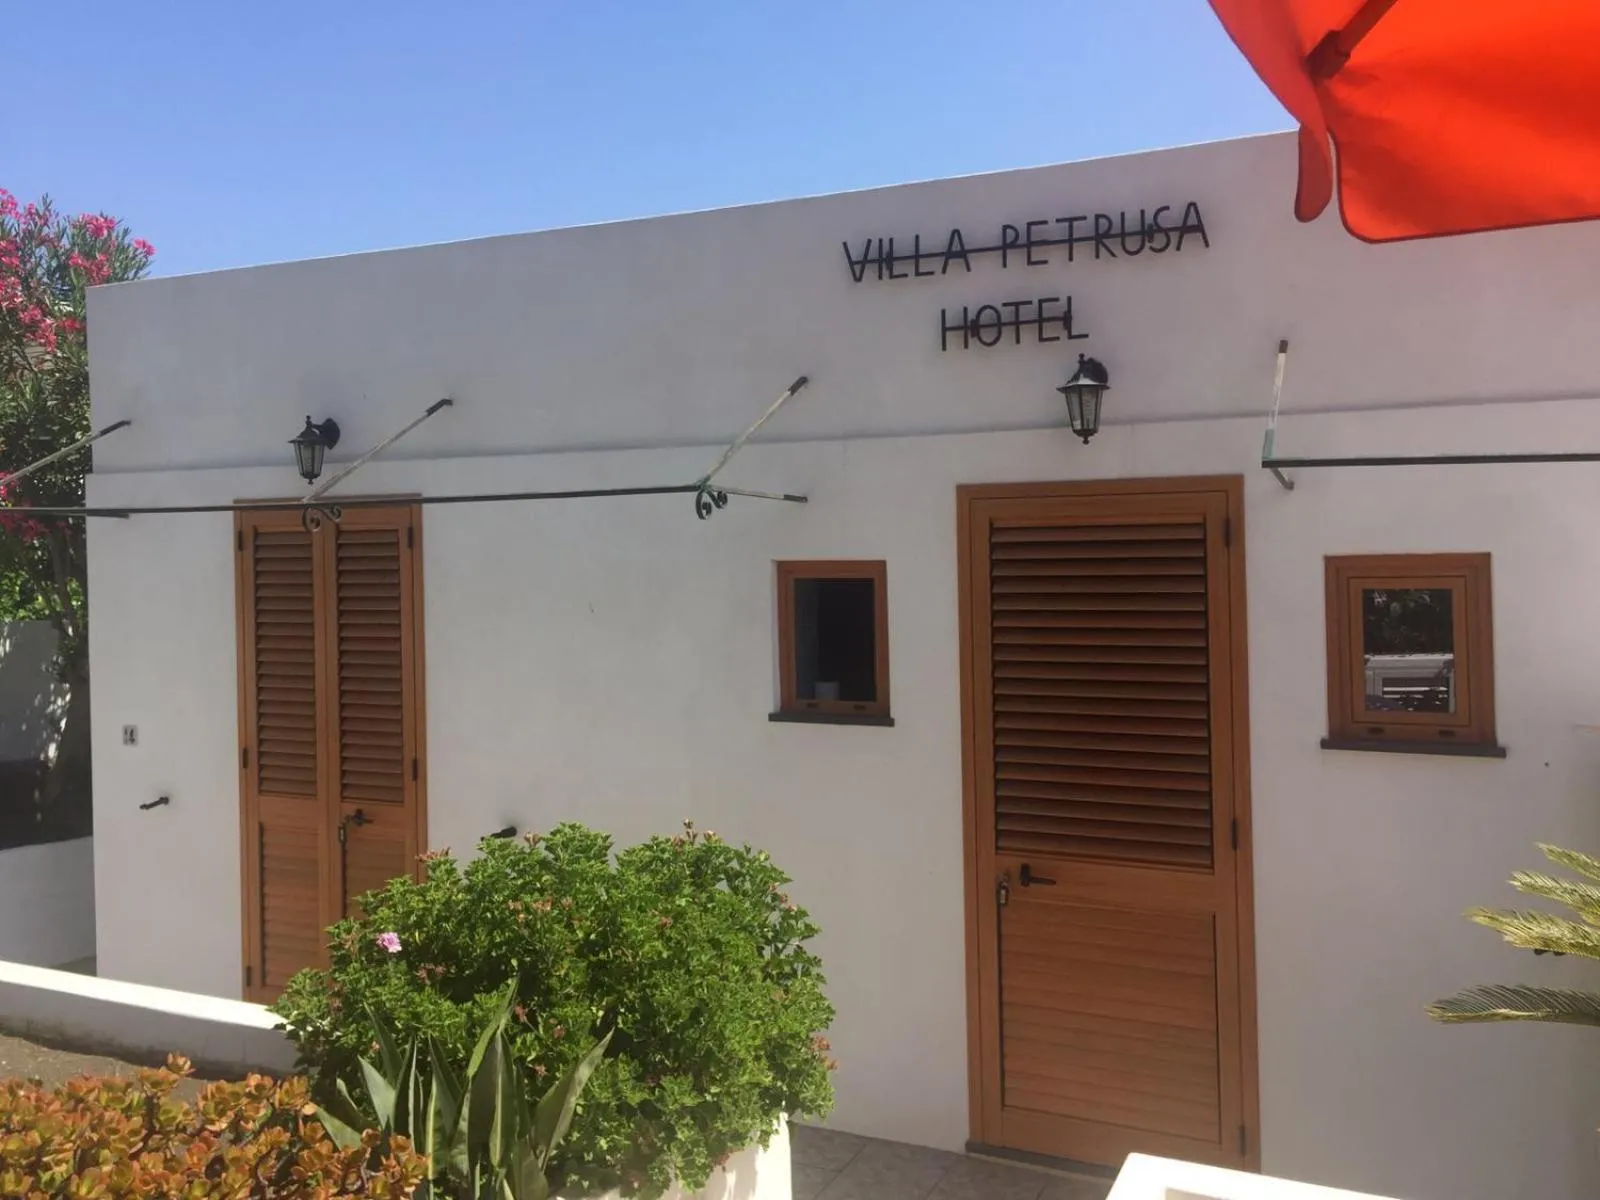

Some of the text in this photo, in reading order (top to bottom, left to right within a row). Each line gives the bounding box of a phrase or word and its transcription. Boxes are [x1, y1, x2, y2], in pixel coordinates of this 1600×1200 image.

[843, 201, 1210, 282] VILLA PETRUSA
[940, 296, 1090, 352] HOTEL
